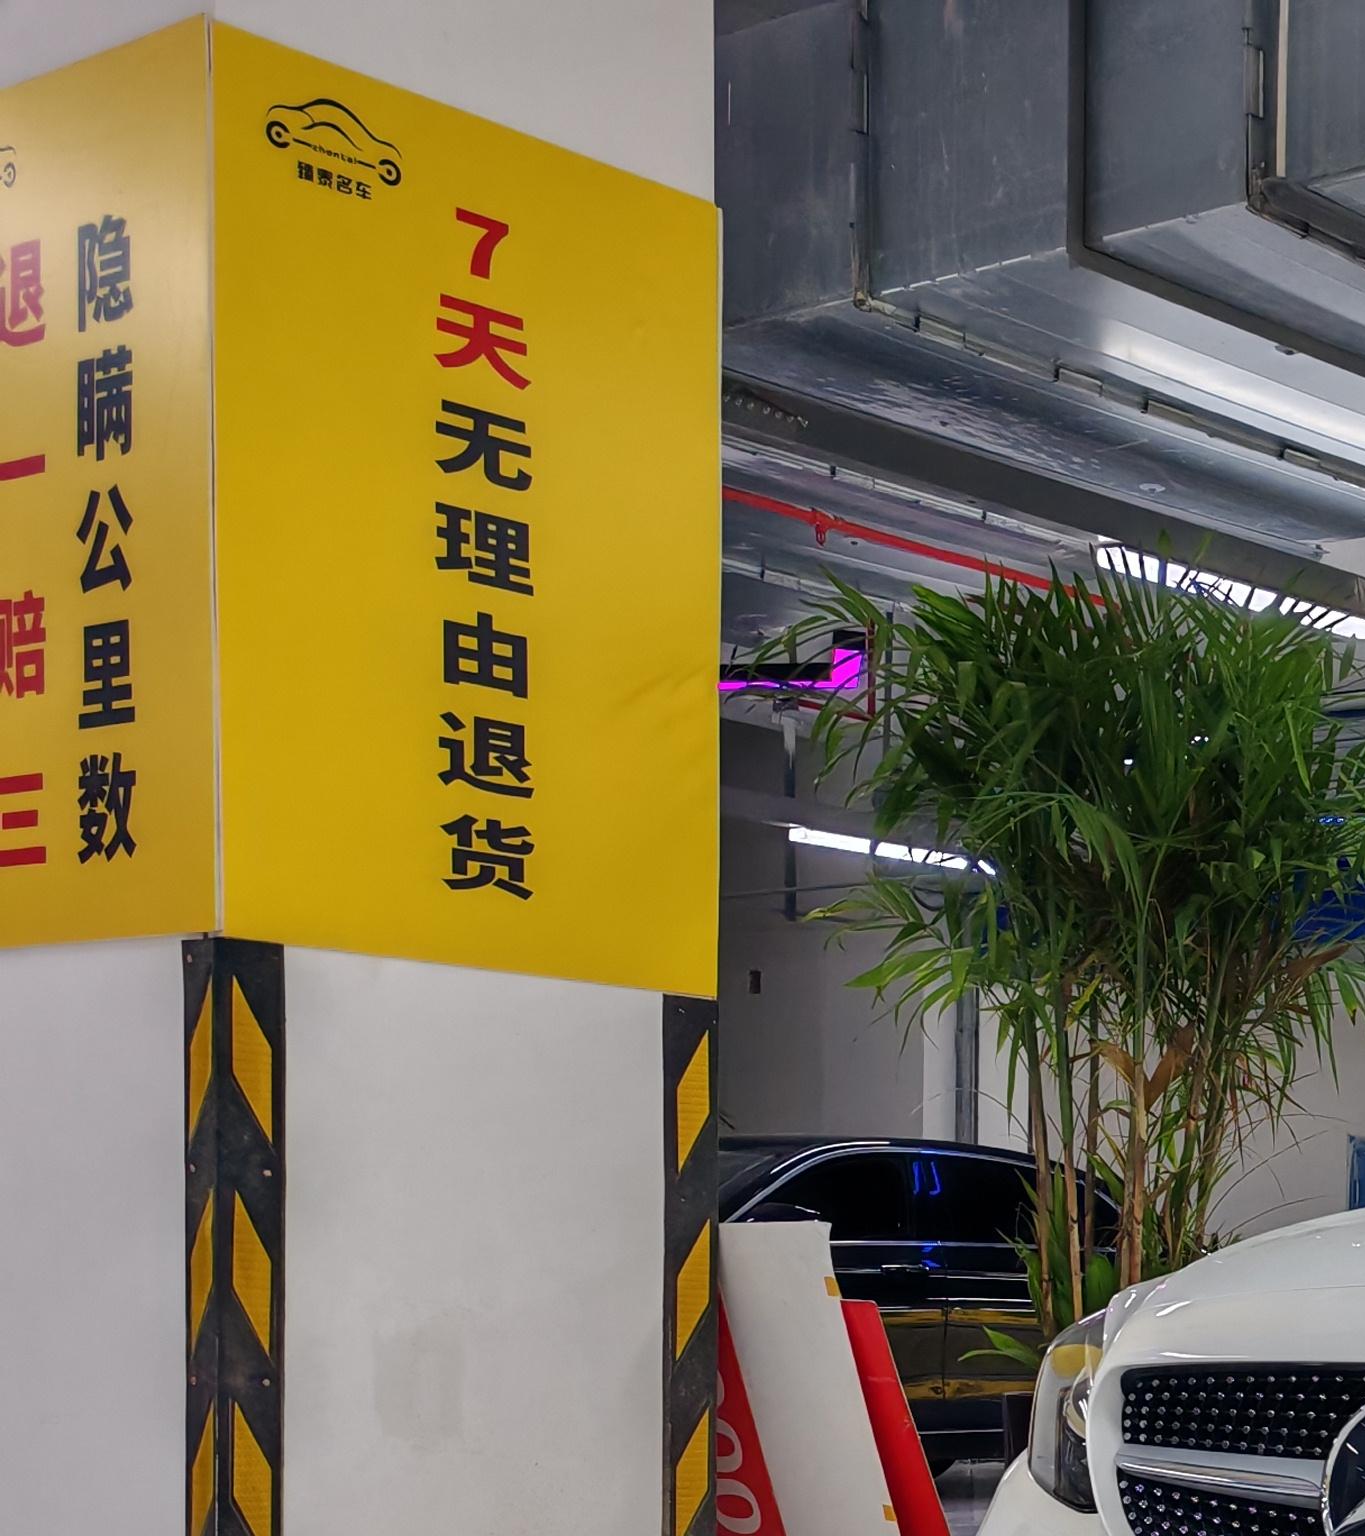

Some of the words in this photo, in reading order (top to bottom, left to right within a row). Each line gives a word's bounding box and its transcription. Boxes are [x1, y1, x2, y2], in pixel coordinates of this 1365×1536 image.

[77, 214, 137, 863] 隐瞒公里数
[435, 207, 535, 900] 7天无理由退货
